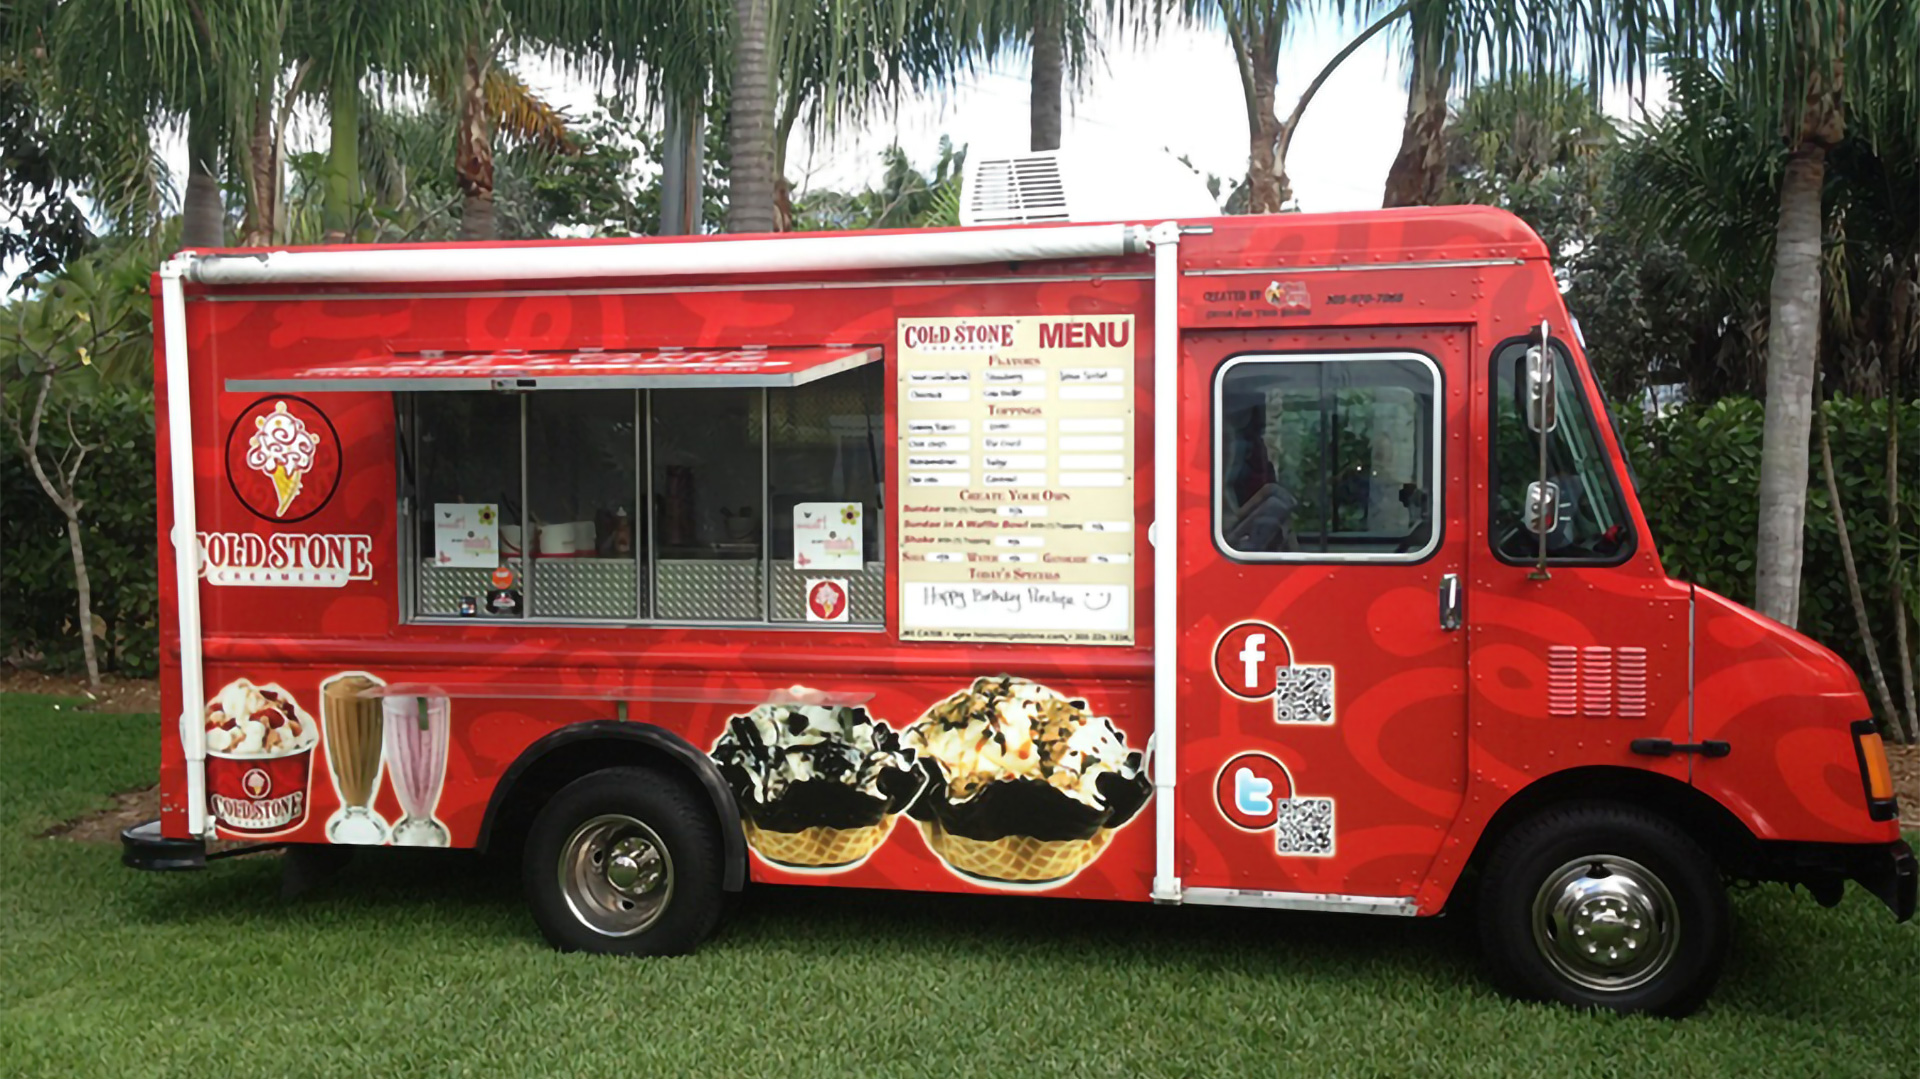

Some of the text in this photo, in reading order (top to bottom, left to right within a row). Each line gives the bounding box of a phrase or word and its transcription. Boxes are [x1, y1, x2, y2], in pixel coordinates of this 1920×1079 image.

[905, 325, 1014, 348] COLD STONE
[1039, 322, 1129, 348] MENU
[960, 490, 1005, 501] CREATE
[1008, 490, 1040, 501] YOUR
[903, 504, 941, 513] Sundae
[904, 520, 941, 528] Sundae
[269, 535, 370, 577] STONE
[923, 586, 967, 609] Happy
[972, 588, 1022, 613] Birthday
[251, 793, 302, 820] STONE
